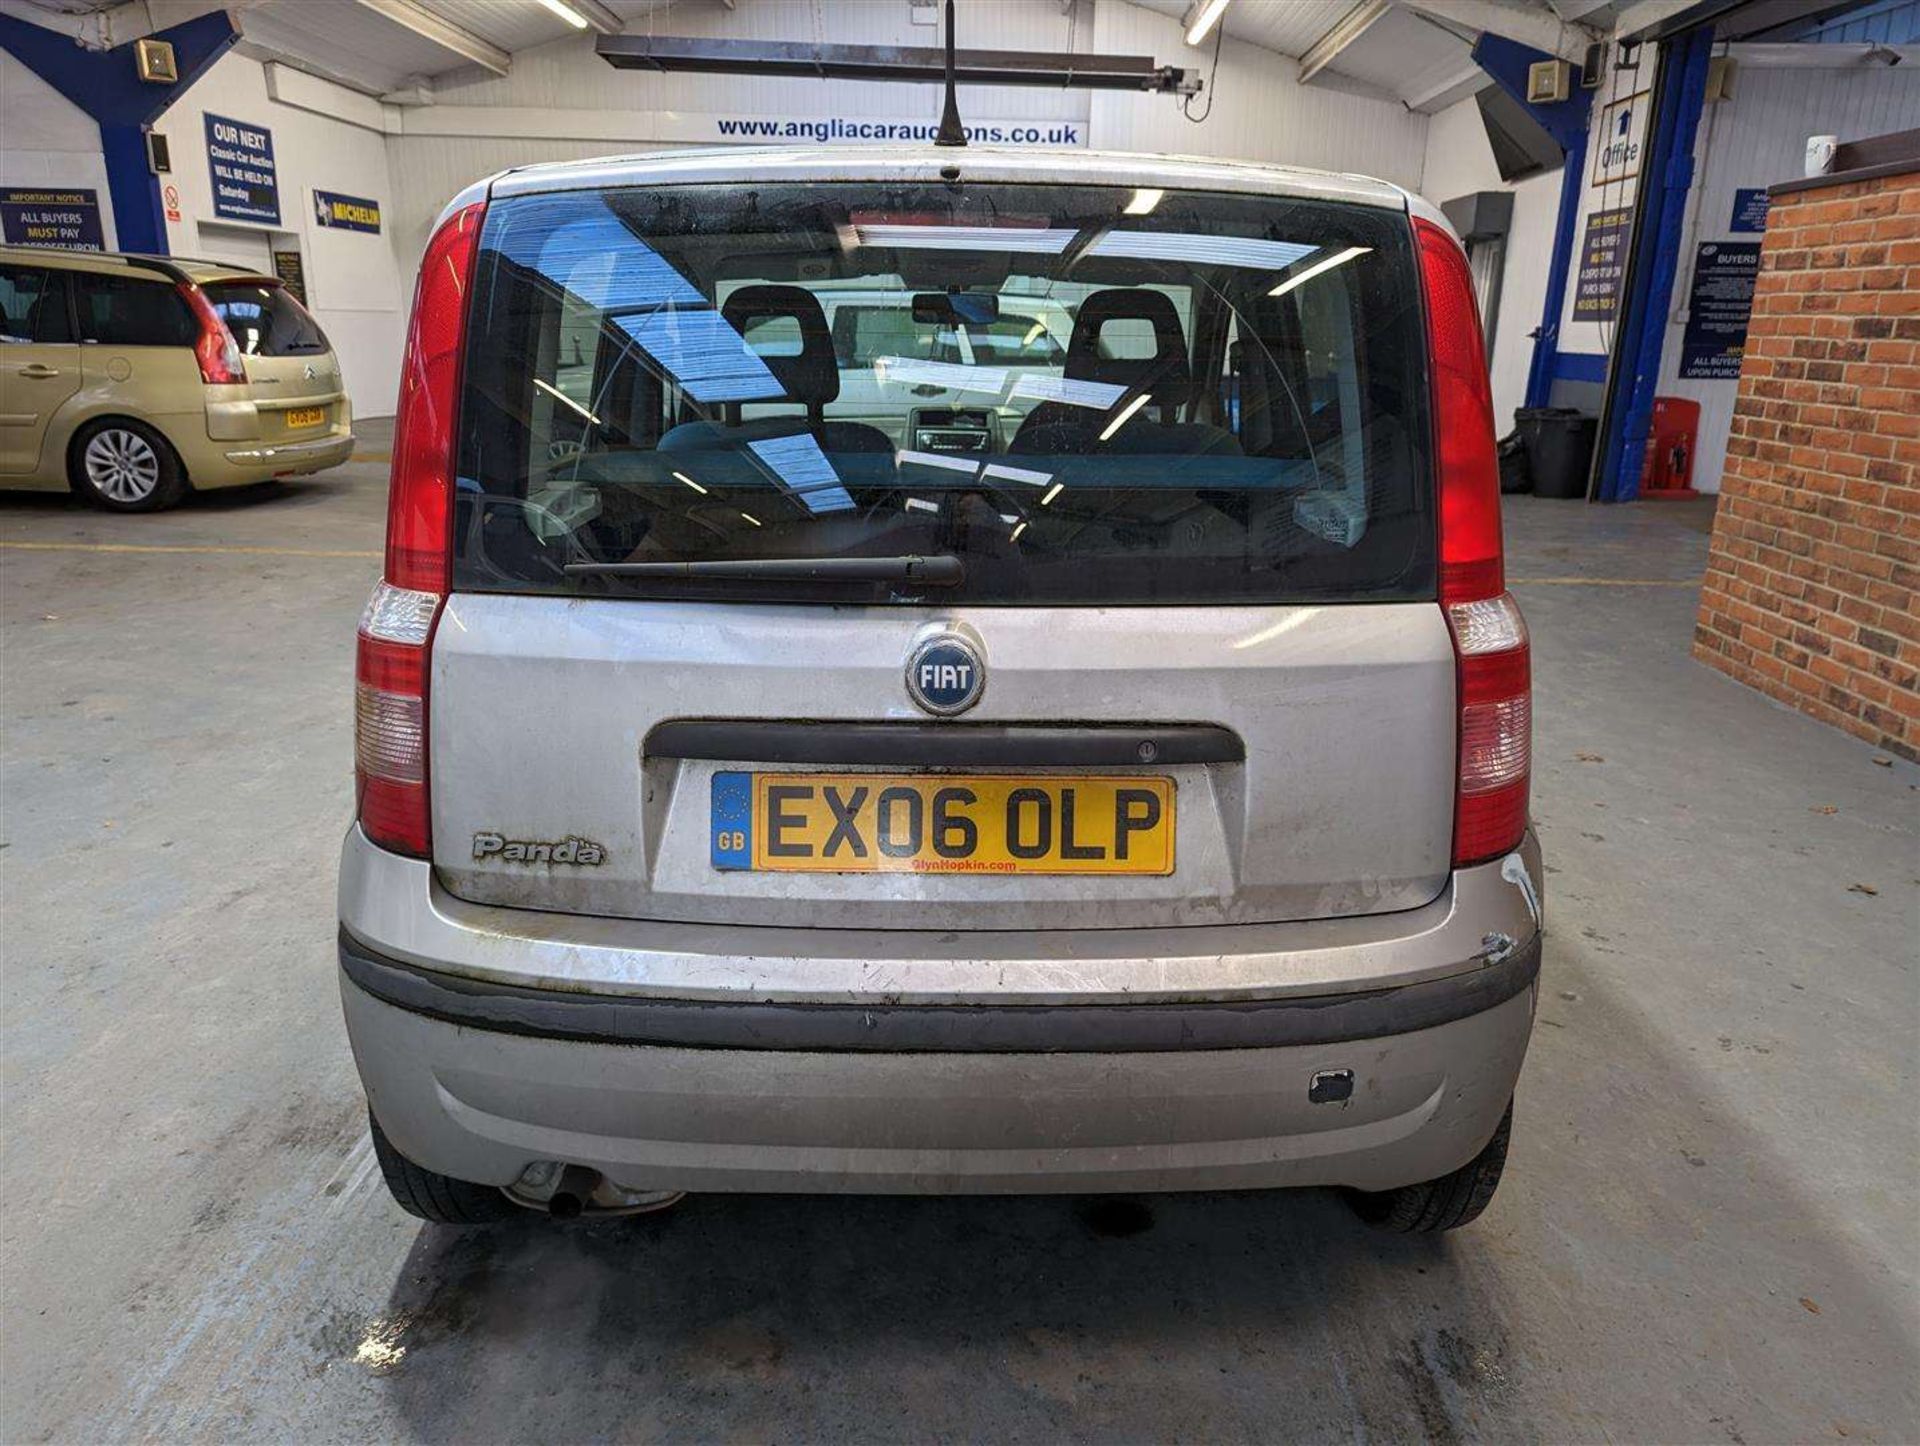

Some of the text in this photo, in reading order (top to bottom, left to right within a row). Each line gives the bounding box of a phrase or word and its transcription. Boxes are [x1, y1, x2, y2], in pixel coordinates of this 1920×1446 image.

[214, 123, 266, 151] OUR NEXT
[717, 119, 1077, 144] www.angliacaraucons.co.uk
[1602, 141, 1639, 169] Office
[214, 165, 234, 180] WILL
[9, 193, 85, 203] IMPORTANT NOTICE
[219, 184, 250, 203] Saturday
[21, 212, 83, 224] ALL BUYERS
[333, 202, 380, 225] MICHELIN
[27, 227, 80, 238] MUST PAY
[1717, 254, 1757, 264] BUYERS
[1693, 356, 1710, 366] ALL
[1687, 368, 1711, 377] UPON
[921, 664, 971, 689] FIAT
[767, 786, 1161, 861] EX06 OLP
[473, 833, 602, 864] Panda
[718, 833, 745, 851] GB
[911, 859, 1017, 873] GlynHopkin.com
